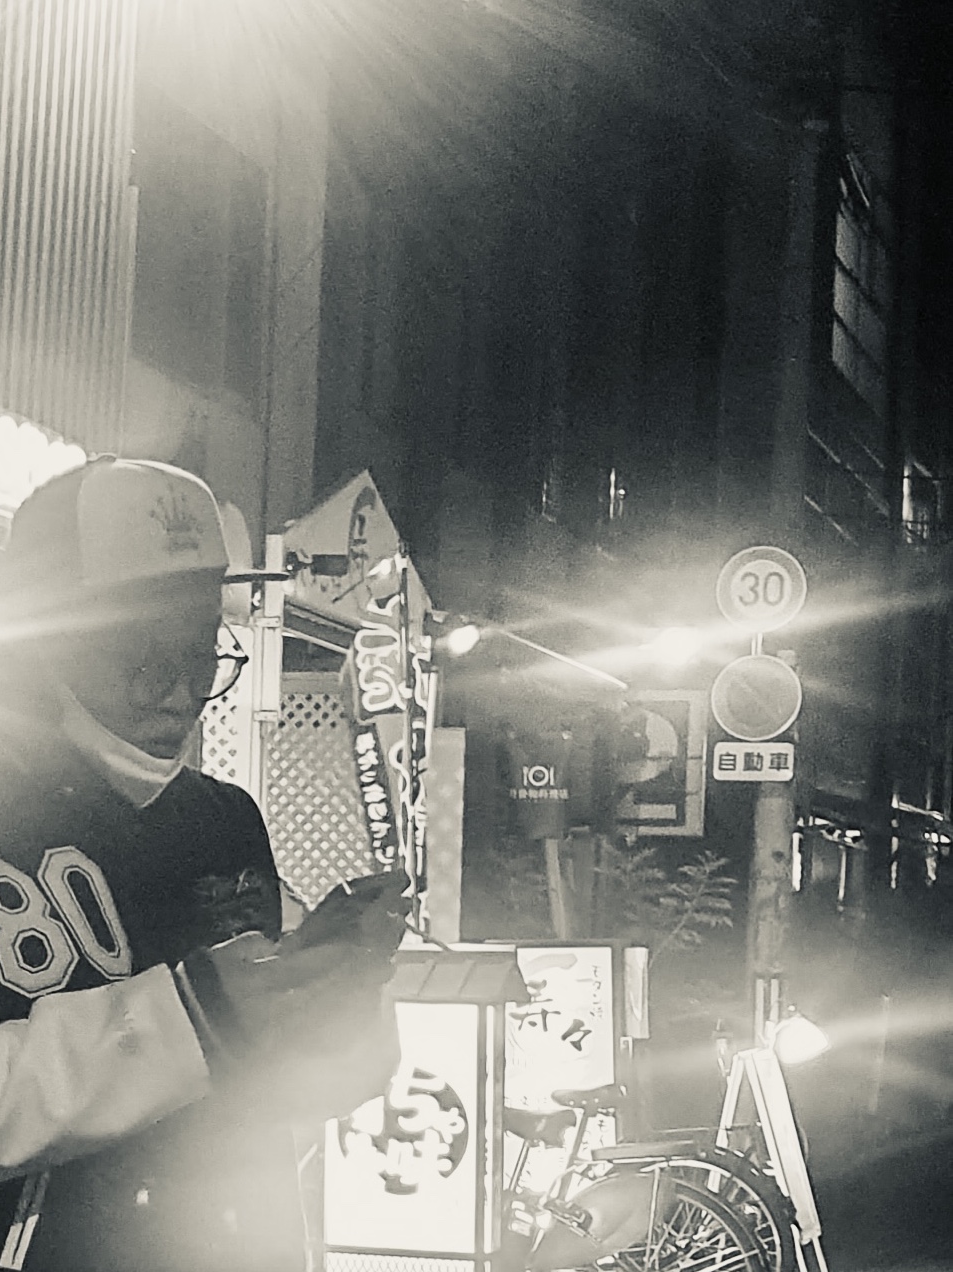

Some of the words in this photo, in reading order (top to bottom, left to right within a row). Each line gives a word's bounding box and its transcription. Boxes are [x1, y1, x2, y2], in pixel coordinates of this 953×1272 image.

[738, 571, 785, 607] 30
[718, 752, 790, 772] 自動車
